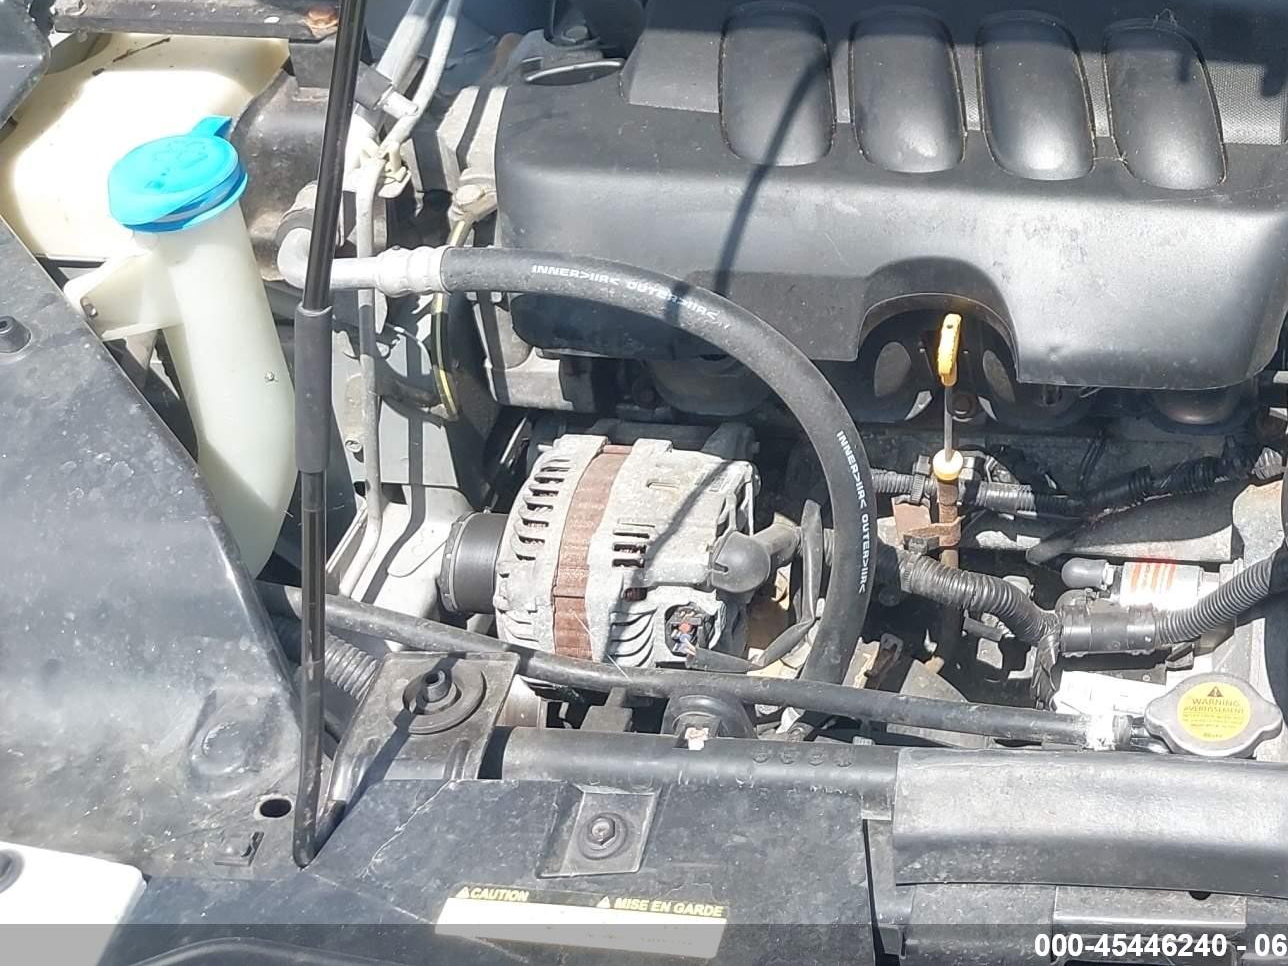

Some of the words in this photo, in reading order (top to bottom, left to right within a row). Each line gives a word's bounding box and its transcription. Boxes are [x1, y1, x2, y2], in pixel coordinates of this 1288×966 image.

[1192, 698, 1241, 707] WARNING
[470, 887, 529, 903] CAUTION
[614, 897, 650, 912] MISE
[651, 900, 671, 914] EN
[673, 903, 724, 919] GARDE
